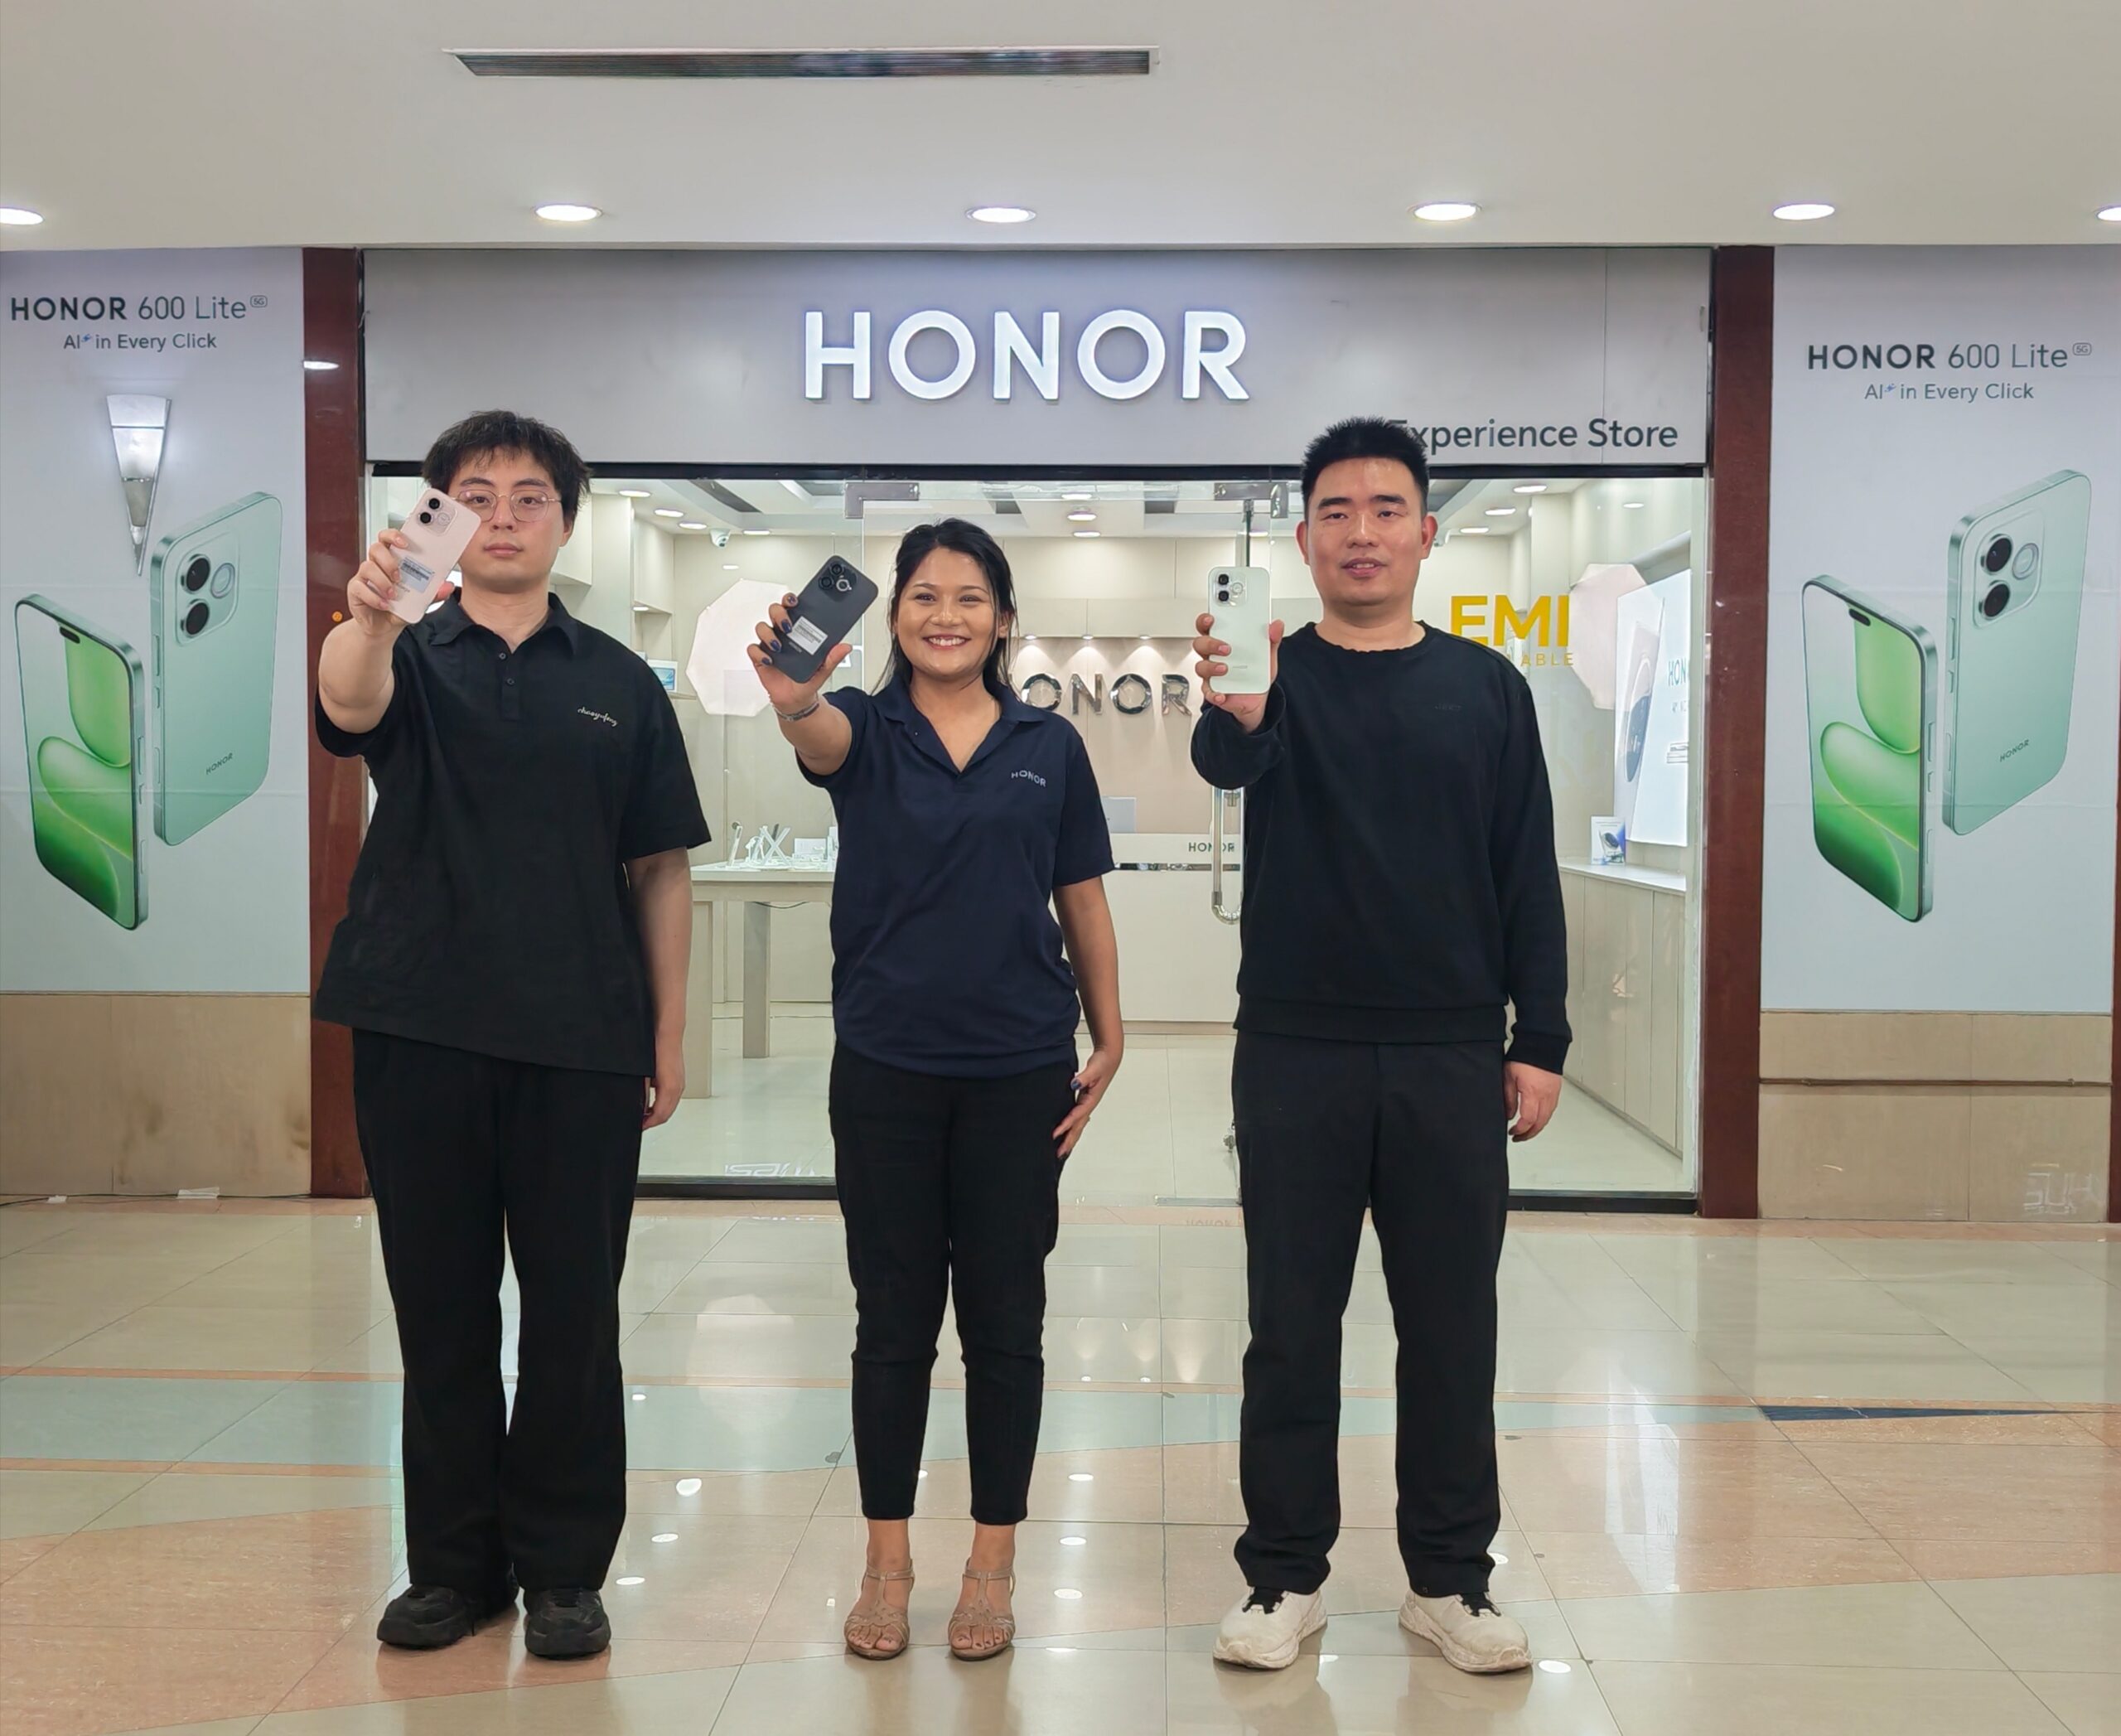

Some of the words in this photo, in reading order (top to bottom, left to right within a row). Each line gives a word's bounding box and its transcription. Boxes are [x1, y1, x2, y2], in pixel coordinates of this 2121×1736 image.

[11, 297, 128, 321] HONOR
[138, 296, 186, 320] 600
[196, 296, 246, 319] Lite
[252, 297, 266, 307] 5G
[64, 335, 80, 349] AI
[96, 335, 110, 349] in
[118, 334, 166, 352] Every
[173, 332, 217, 349] Click
[805, 309, 1249, 400] HONOR
[1808, 344, 1935, 370] HONOR
[1948, 344, 2000, 369] 600
[2012, 343, 2068, 368] Lite
[2075, 344, 2090, 355] 5G
[1864, 384, 1883, 399] AI
[1901, 384, 1916, 399] in
[1925, 384, 1978, 403] Every
[1985, 382, 2034, 399] Click
[1588, 418, 1678, 448] Store
[1451, 595, 1569, 647] EMI
[1008, 673, 1193, 716] ONOR
[1011, 770, 1046, 787] HONOR
